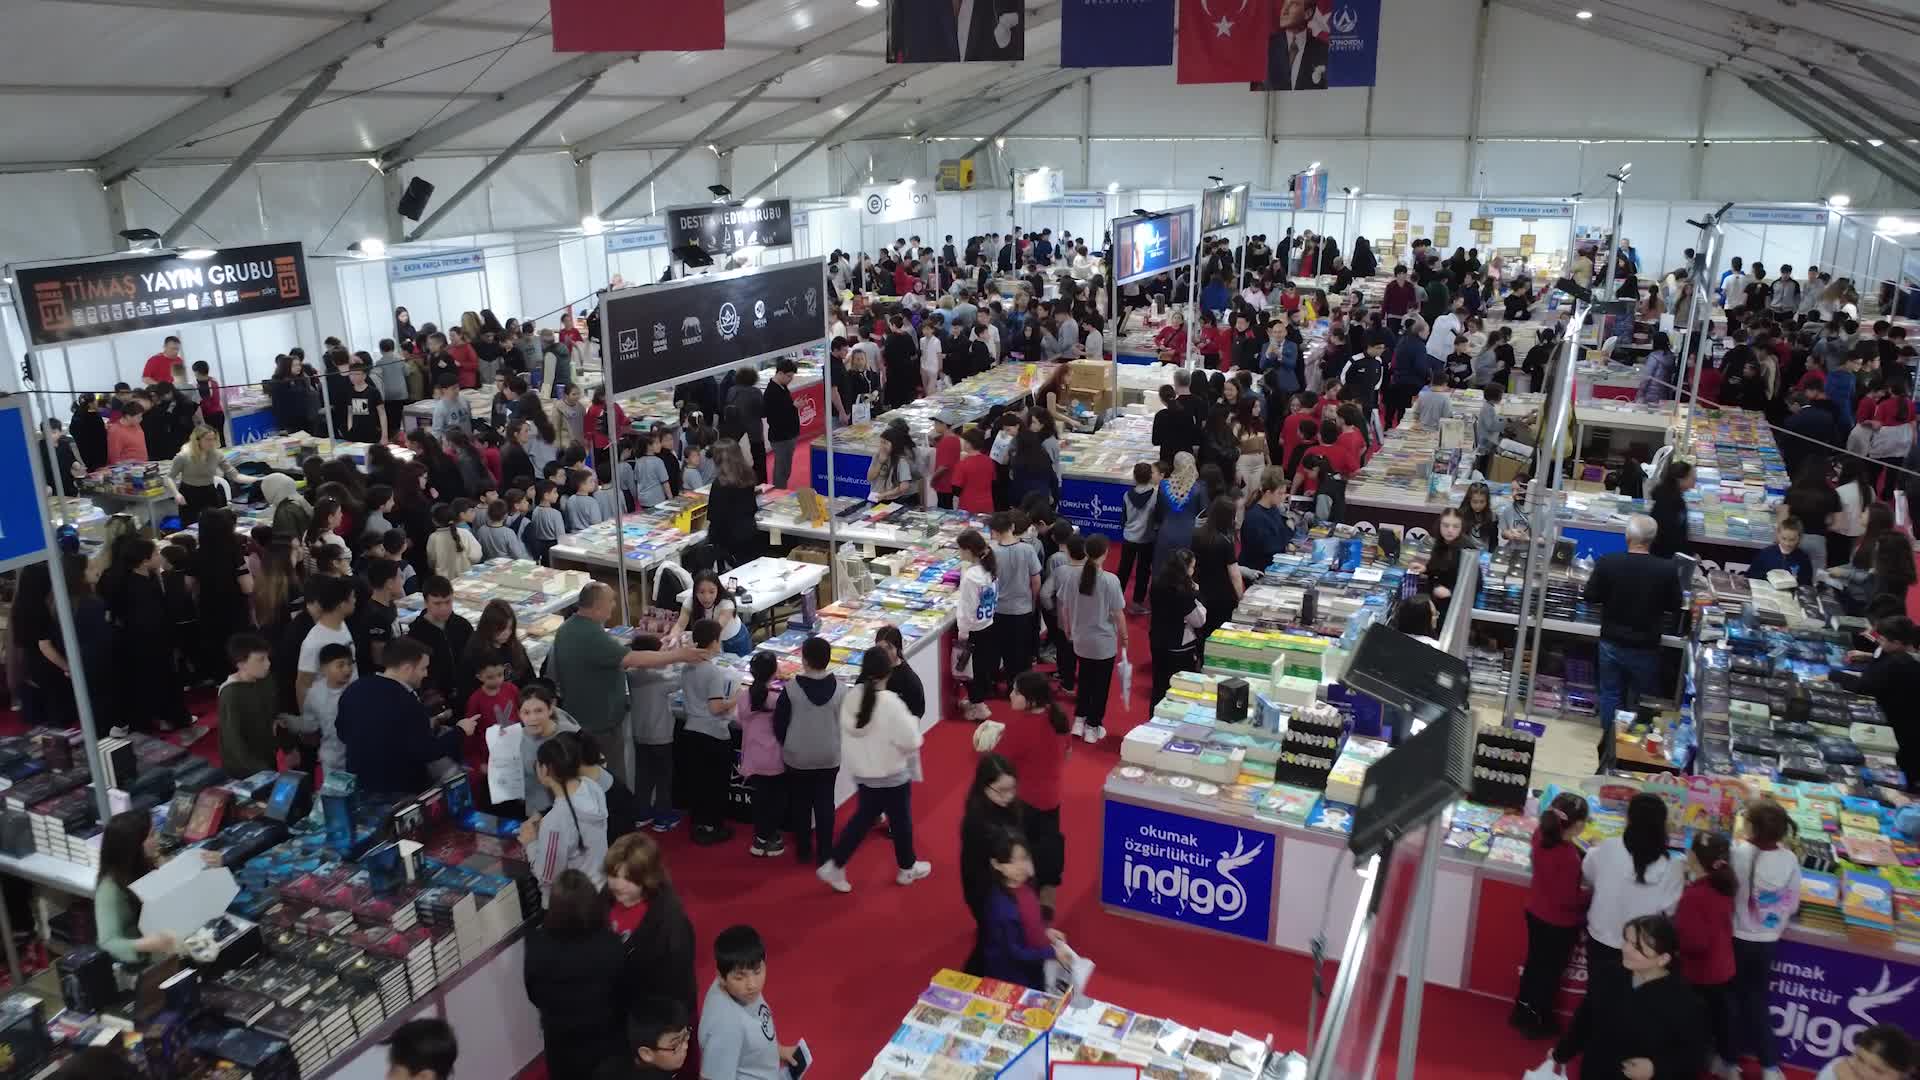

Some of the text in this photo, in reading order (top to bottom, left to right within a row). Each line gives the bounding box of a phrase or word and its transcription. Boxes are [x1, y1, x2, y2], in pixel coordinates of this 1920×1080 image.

[64, 274, 137, 301] TİMAŞ
[140, 265, 204, 293] YAYIN
[207, 259, 274, 286] GRUBU
[1140, 825, 1198, 847] okumak
[1125, 837, 1212, 868] özgürlüktür
[1124, 854, 1247, 920] indigo
[1770, 960, 1825, 981] umak
[1768, 979, 1843, 1005] rlüktür
[1768, 1001, 1869, 1058] digo
